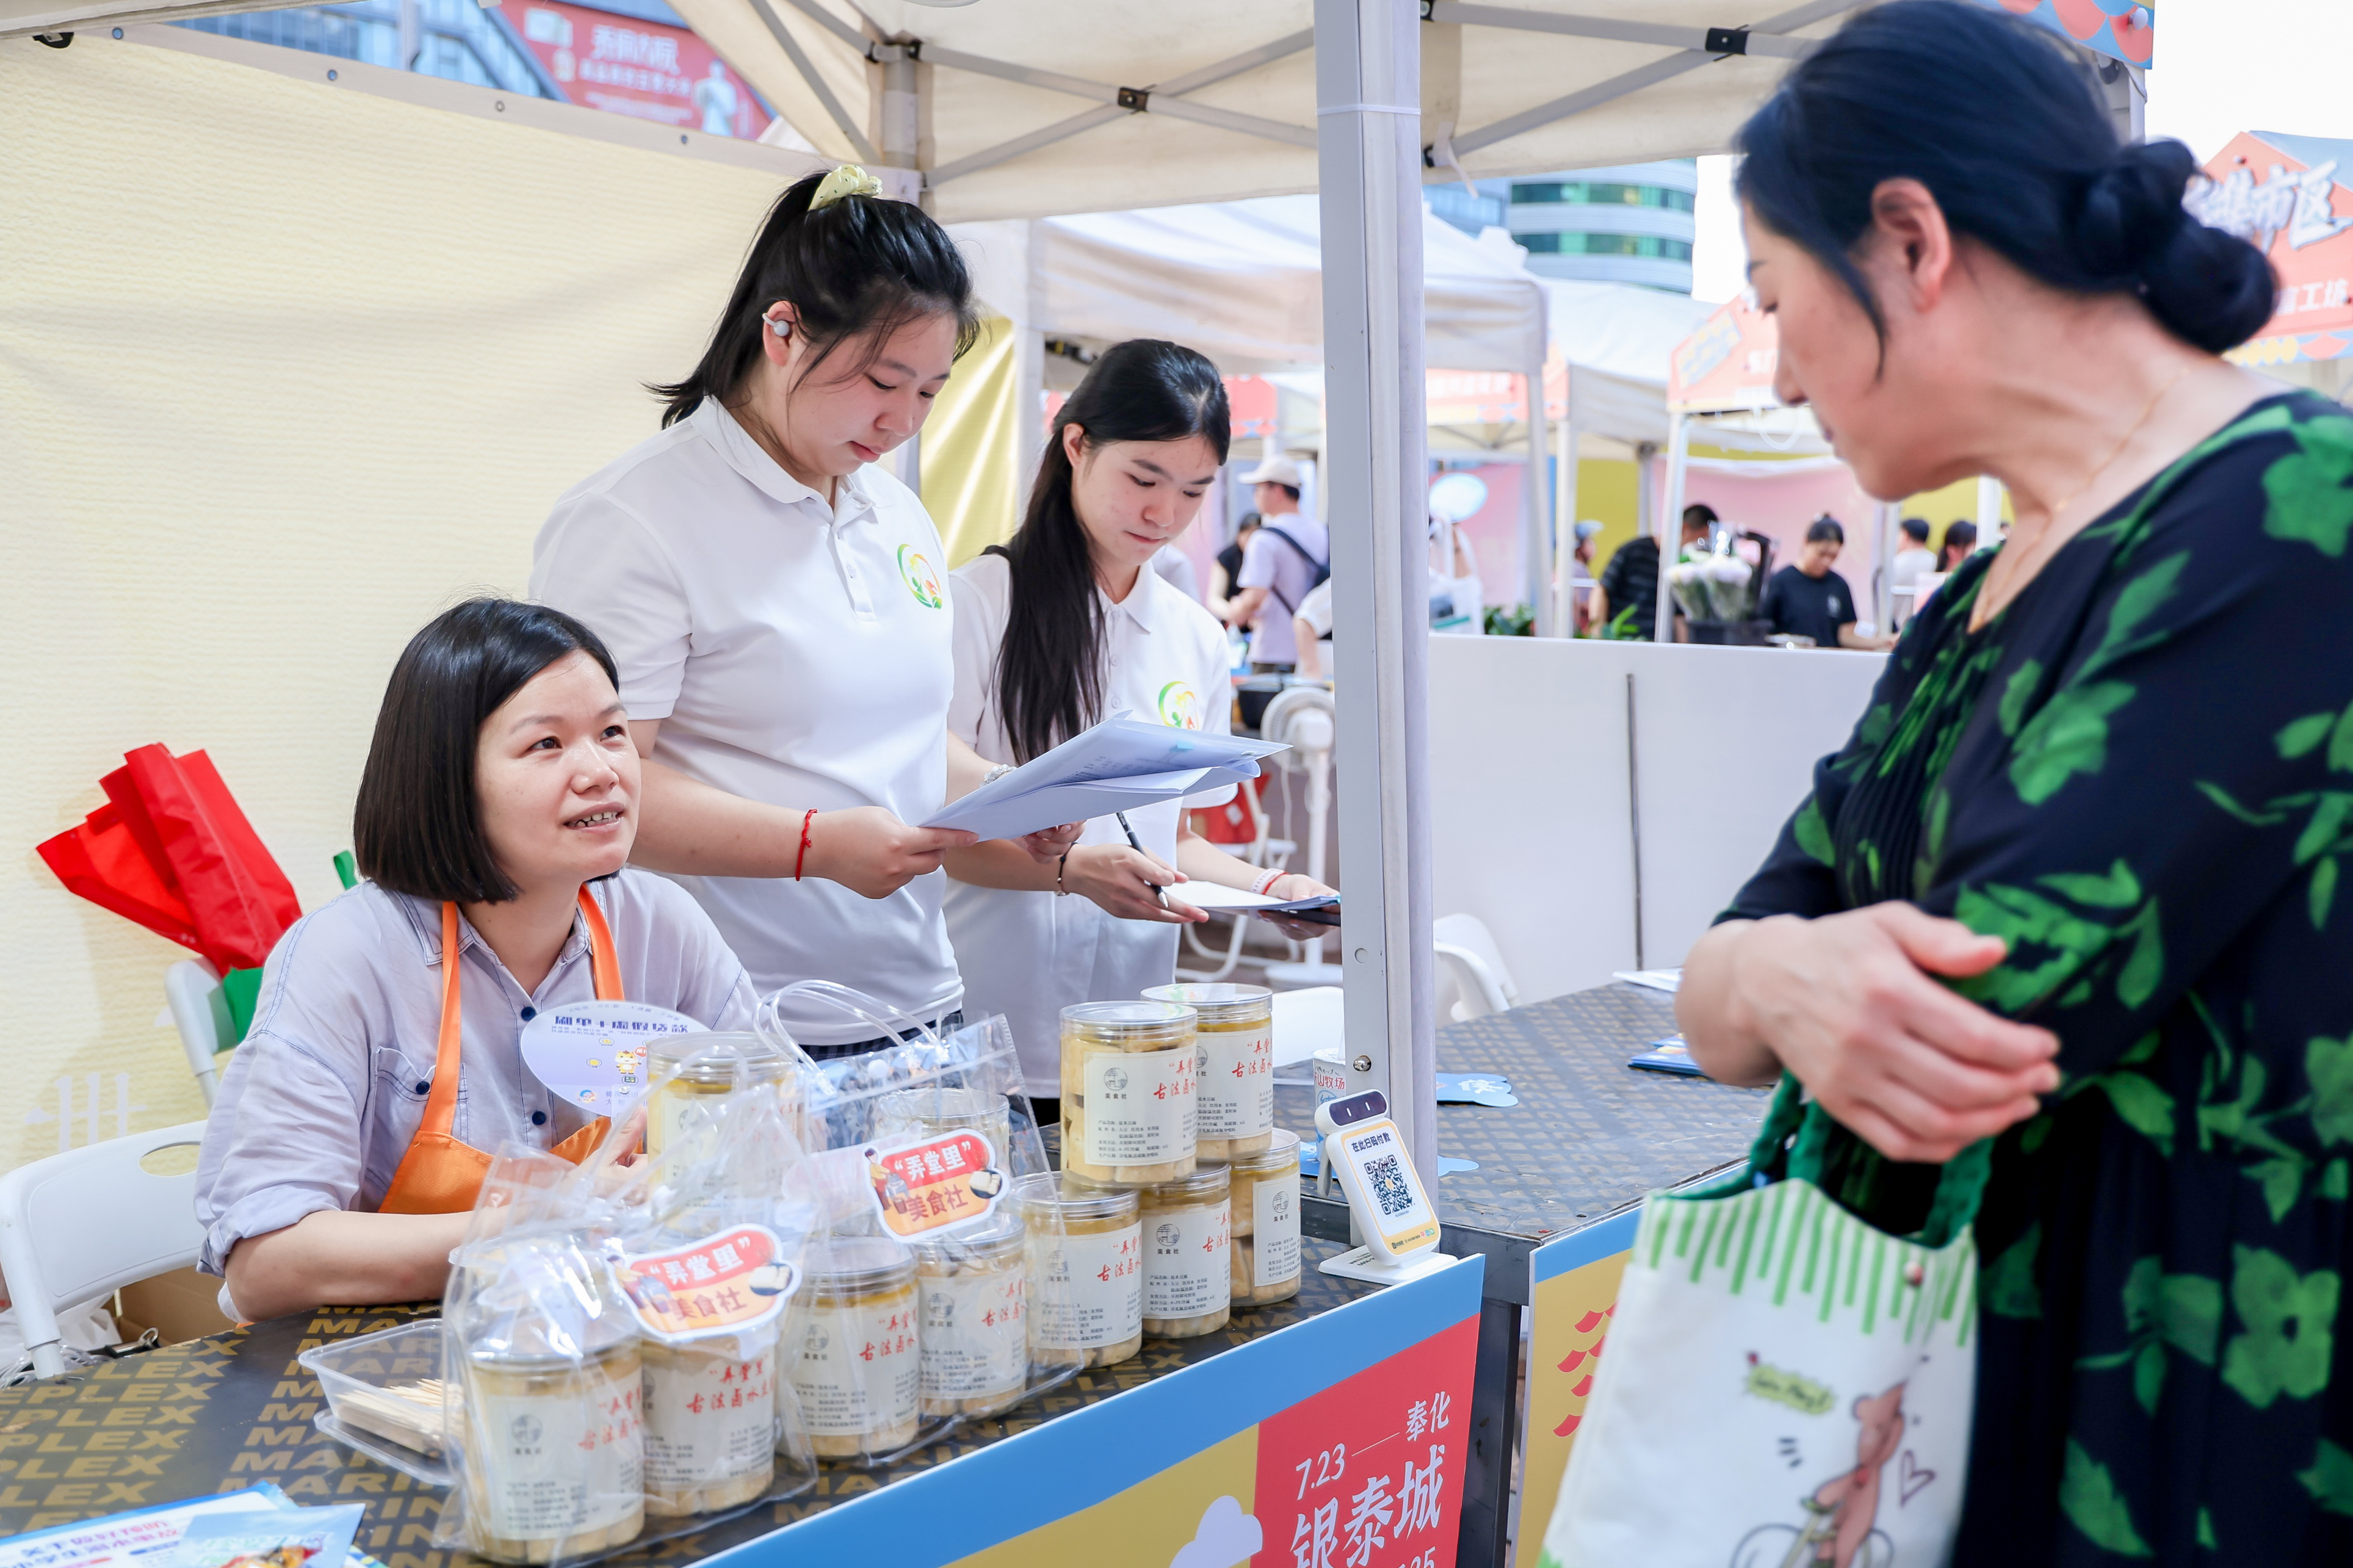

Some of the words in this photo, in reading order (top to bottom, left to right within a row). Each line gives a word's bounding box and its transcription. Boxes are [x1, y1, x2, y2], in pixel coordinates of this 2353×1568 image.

[1248, 1038, 1272, 1055] “弄堂
[1169, 1057, 1196, 1075] “弄堂
[1351, 1132, 1391, 1152] 在此扫码付款
[894, 1141, 971, 1182] “弄堂里”
[906, 1184, 969, 1222] 美食社
[649, 1236, 751, 1285] “弄堂里”
[670, 1286, 748, 1322] 美食社
[1296, 1443, 1345, 1500] 7.23
[1406, 1391, 1450, 1442] 奉化
[1290, 1444, 1445, 1568] 银泰城
